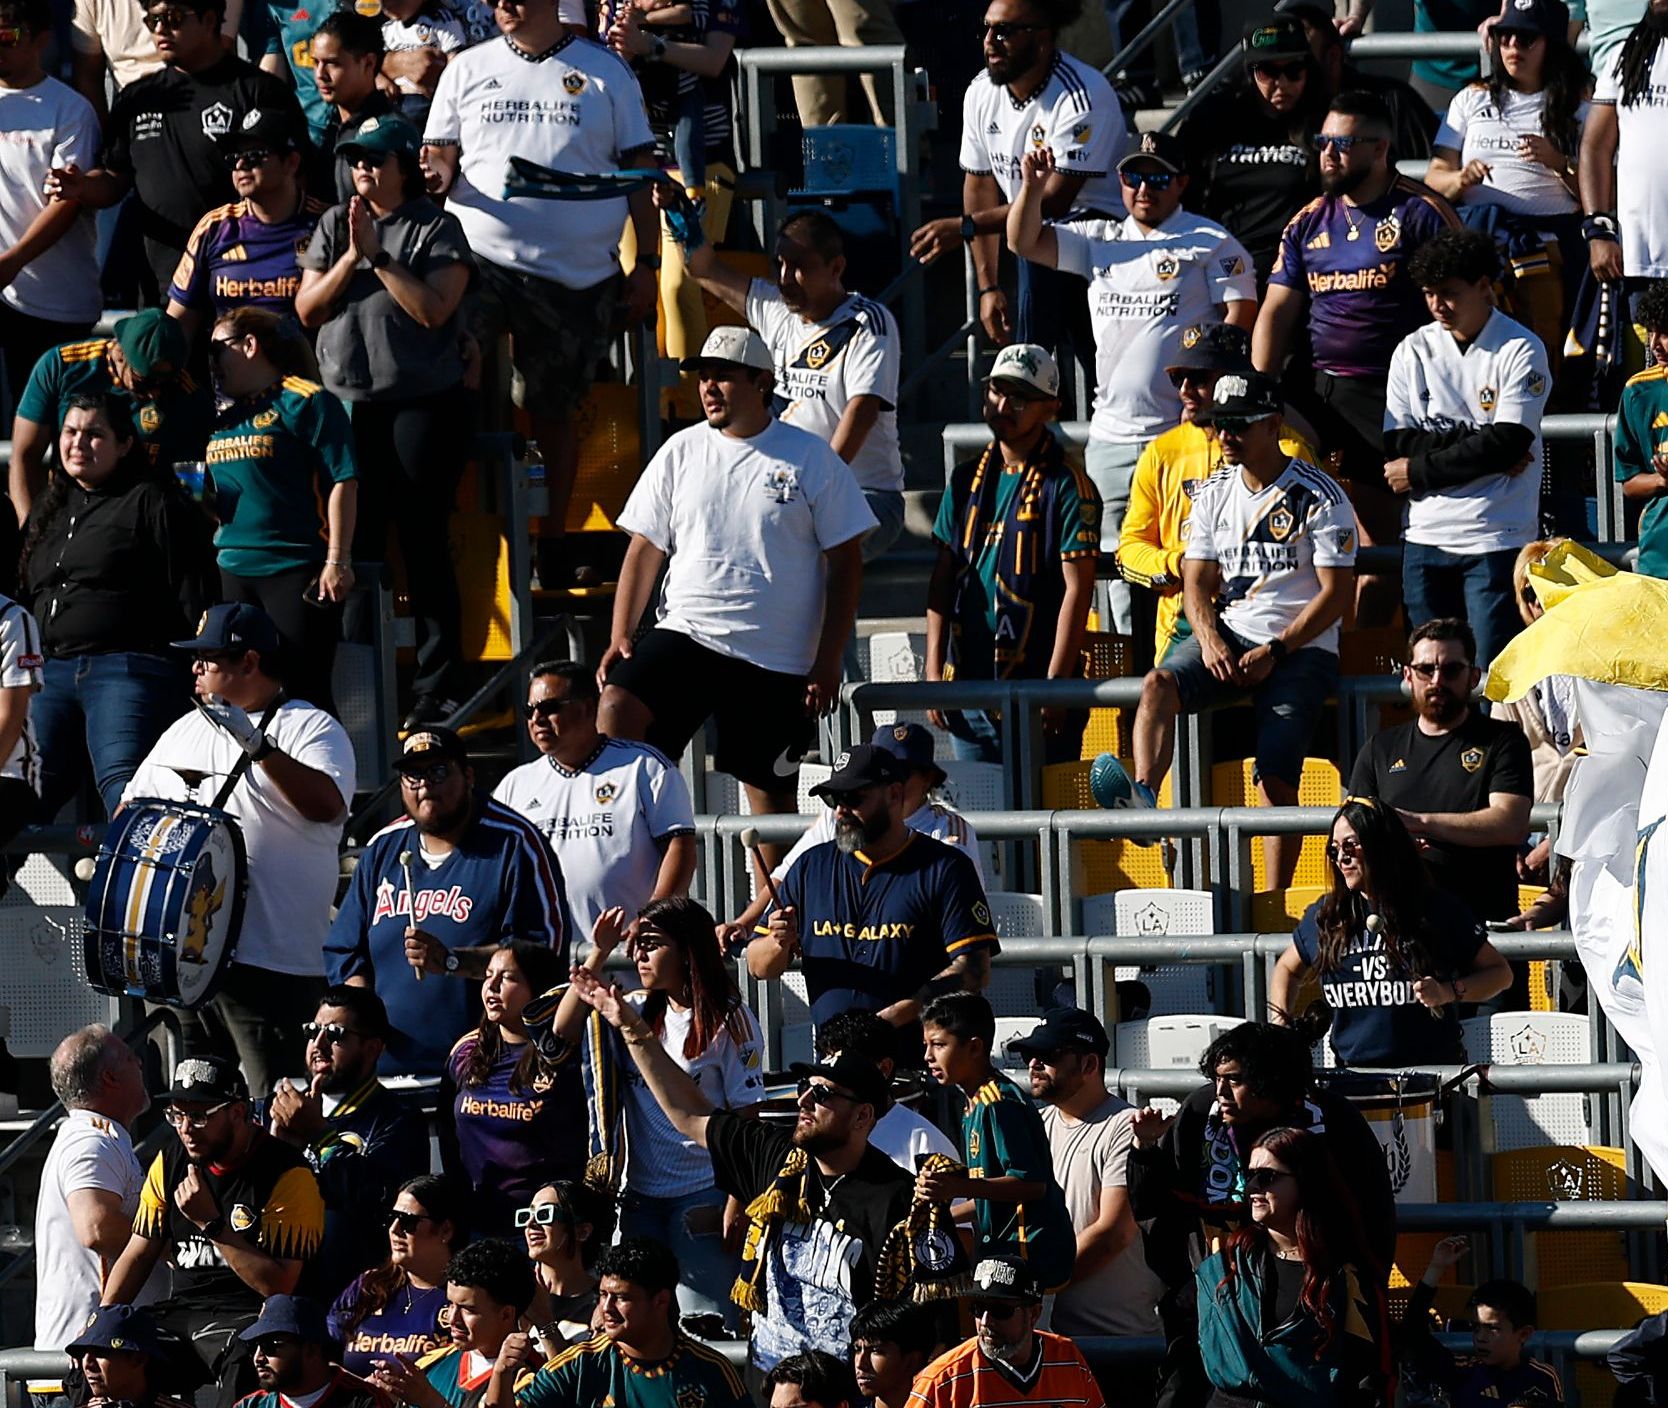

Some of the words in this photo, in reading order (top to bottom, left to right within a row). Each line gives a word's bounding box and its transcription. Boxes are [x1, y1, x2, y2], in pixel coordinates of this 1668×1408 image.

[480, 99, 581, 116] HERBALIFE
[480, 111, 581, 128] NUTRITION
[1307, 271, 1387, 293] Herbalife
[461, 1096, 535, 1121] Herbalife
